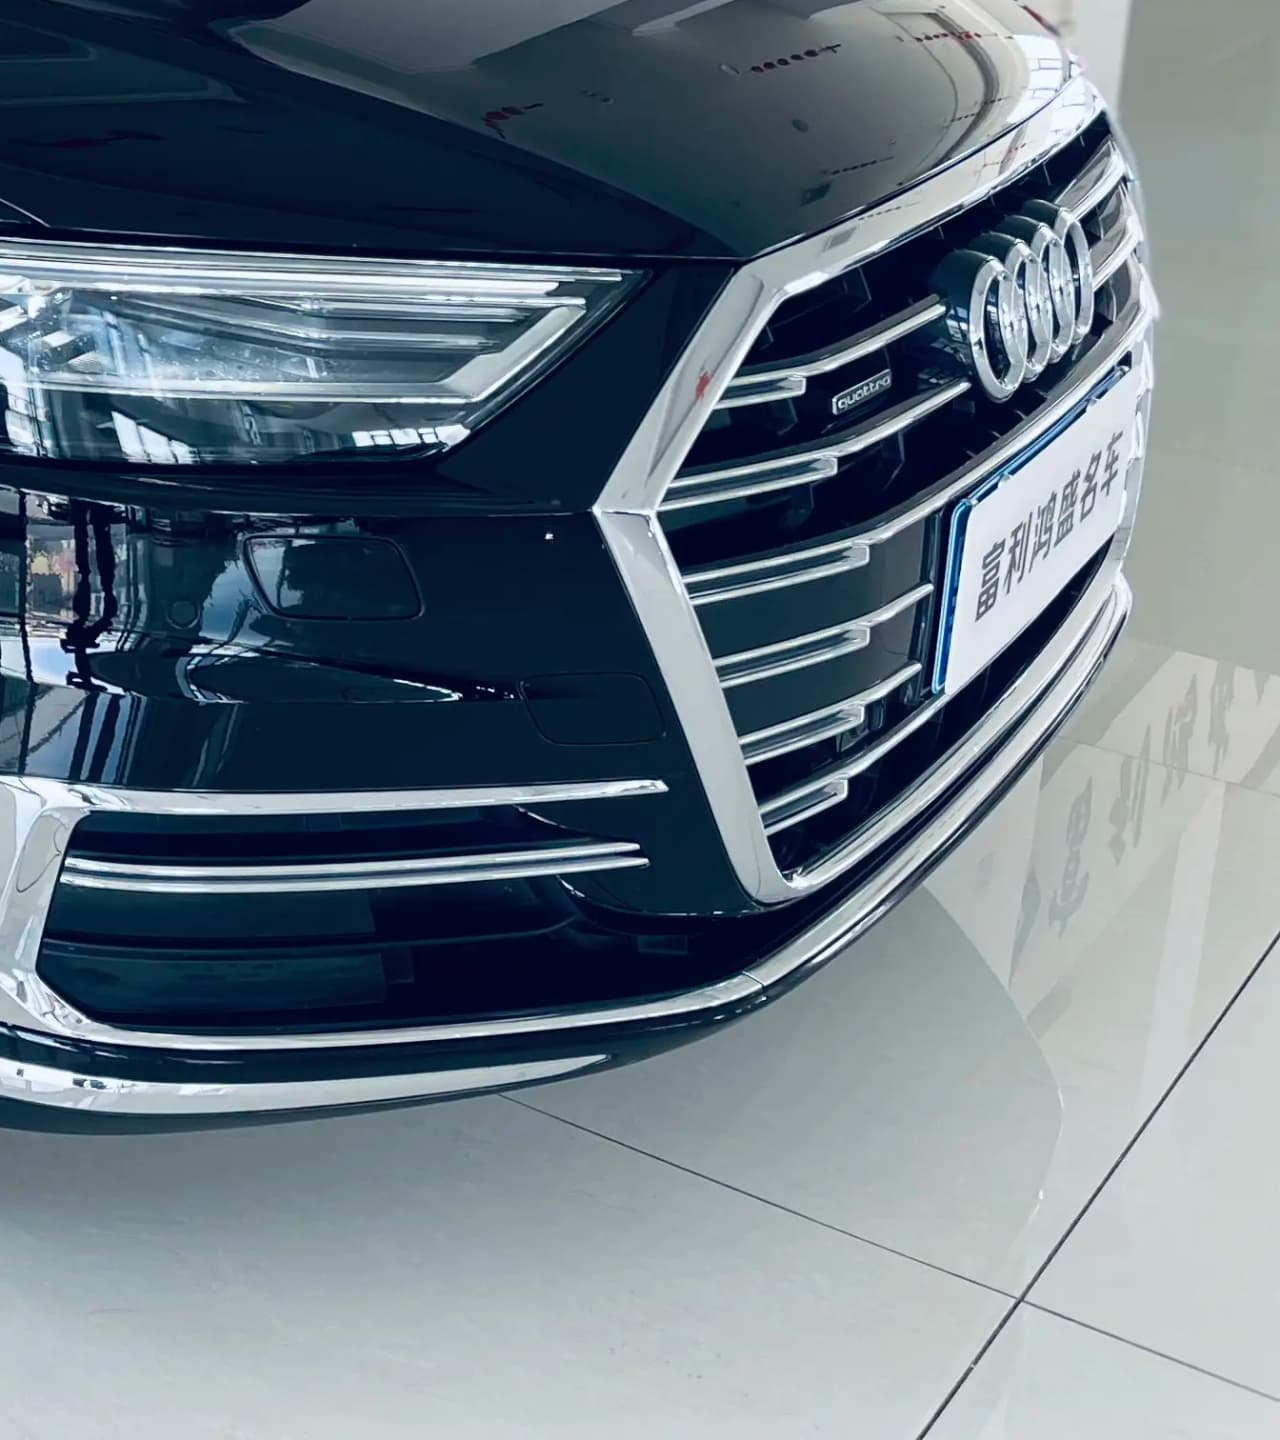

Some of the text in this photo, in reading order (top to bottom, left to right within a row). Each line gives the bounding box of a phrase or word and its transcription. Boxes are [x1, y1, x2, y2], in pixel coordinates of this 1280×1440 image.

[837, 375, 890, 410] quattro
[975, 430, 1124, 622] 富利鸿盛名车
